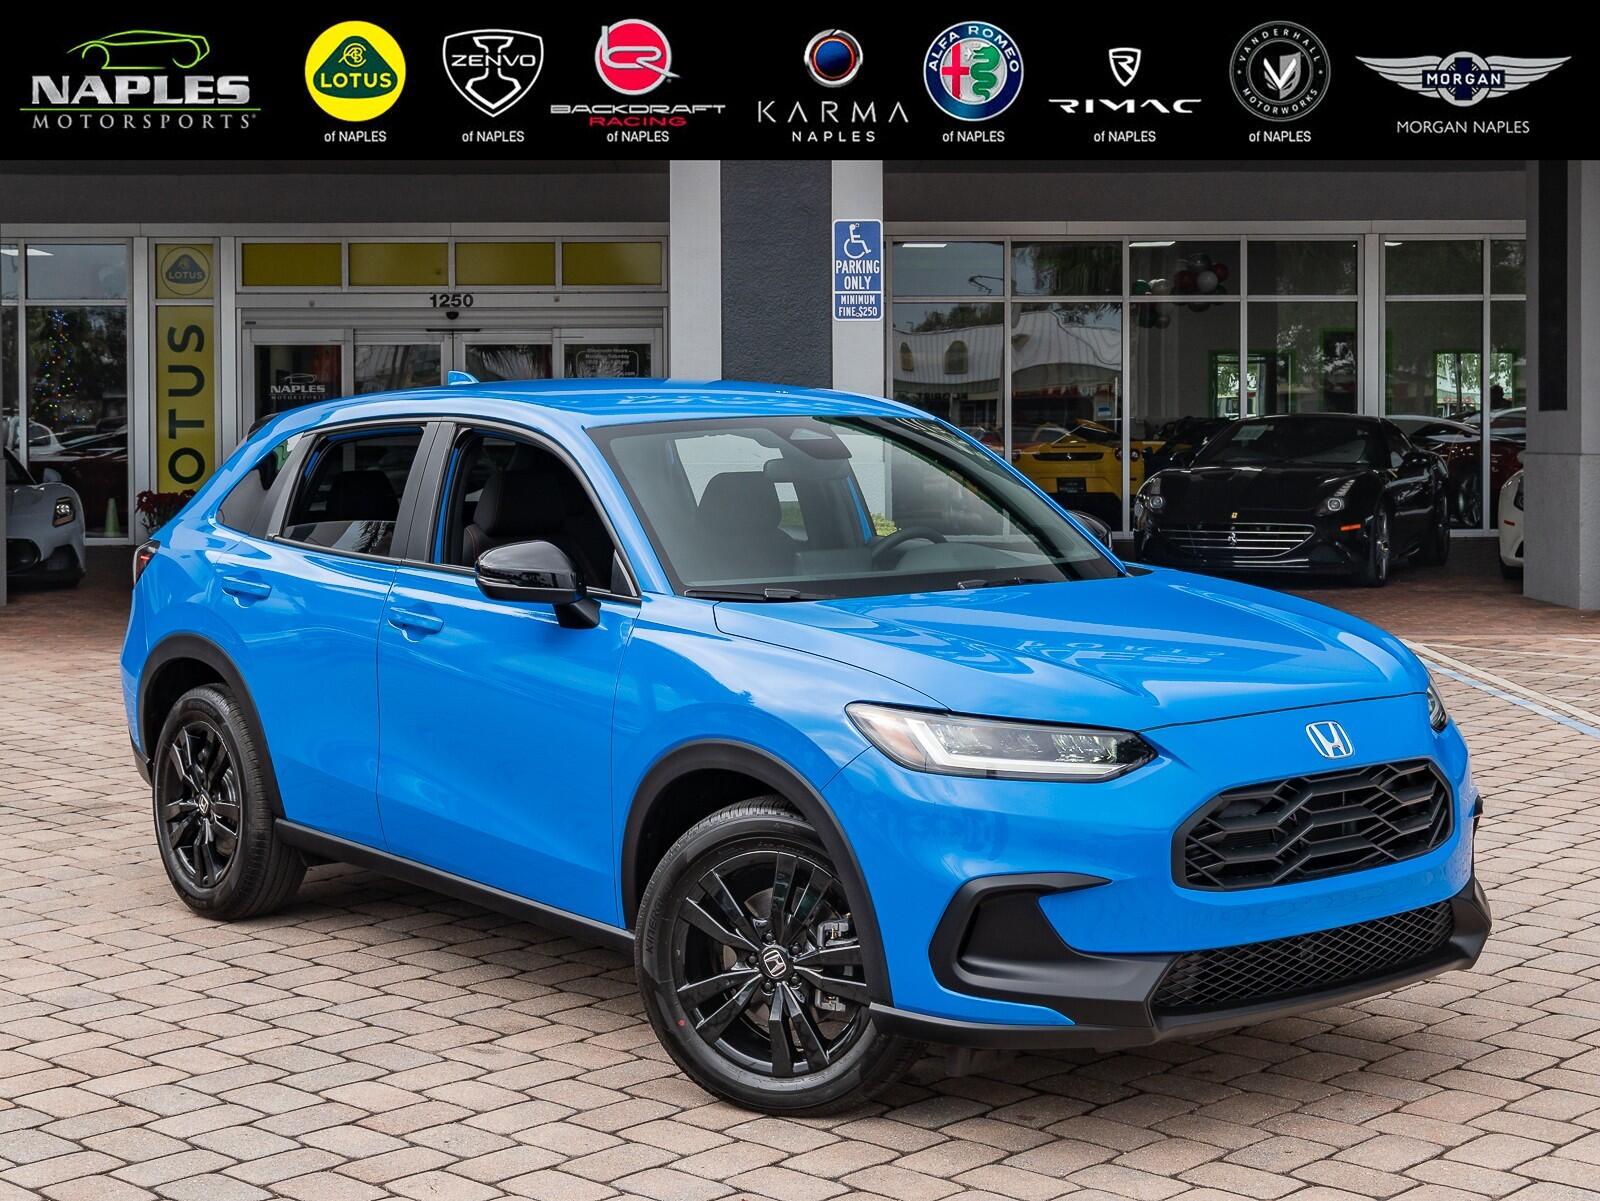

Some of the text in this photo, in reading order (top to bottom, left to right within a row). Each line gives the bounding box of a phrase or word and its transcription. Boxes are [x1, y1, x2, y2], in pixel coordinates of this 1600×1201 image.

[836, 260, 880, 274] PARKING
[168, 271, 203, 280] LOTUS
[844, 276, 872, 291] ONLY
[429, 294, 473, 308] 1250
[841, 294, 875, 305] MINIMUM
[838, 306, 878, 317] FINE $250
[270, 385, 326, 393] NAPLES
[168, 324, 205, 484] OTUS
